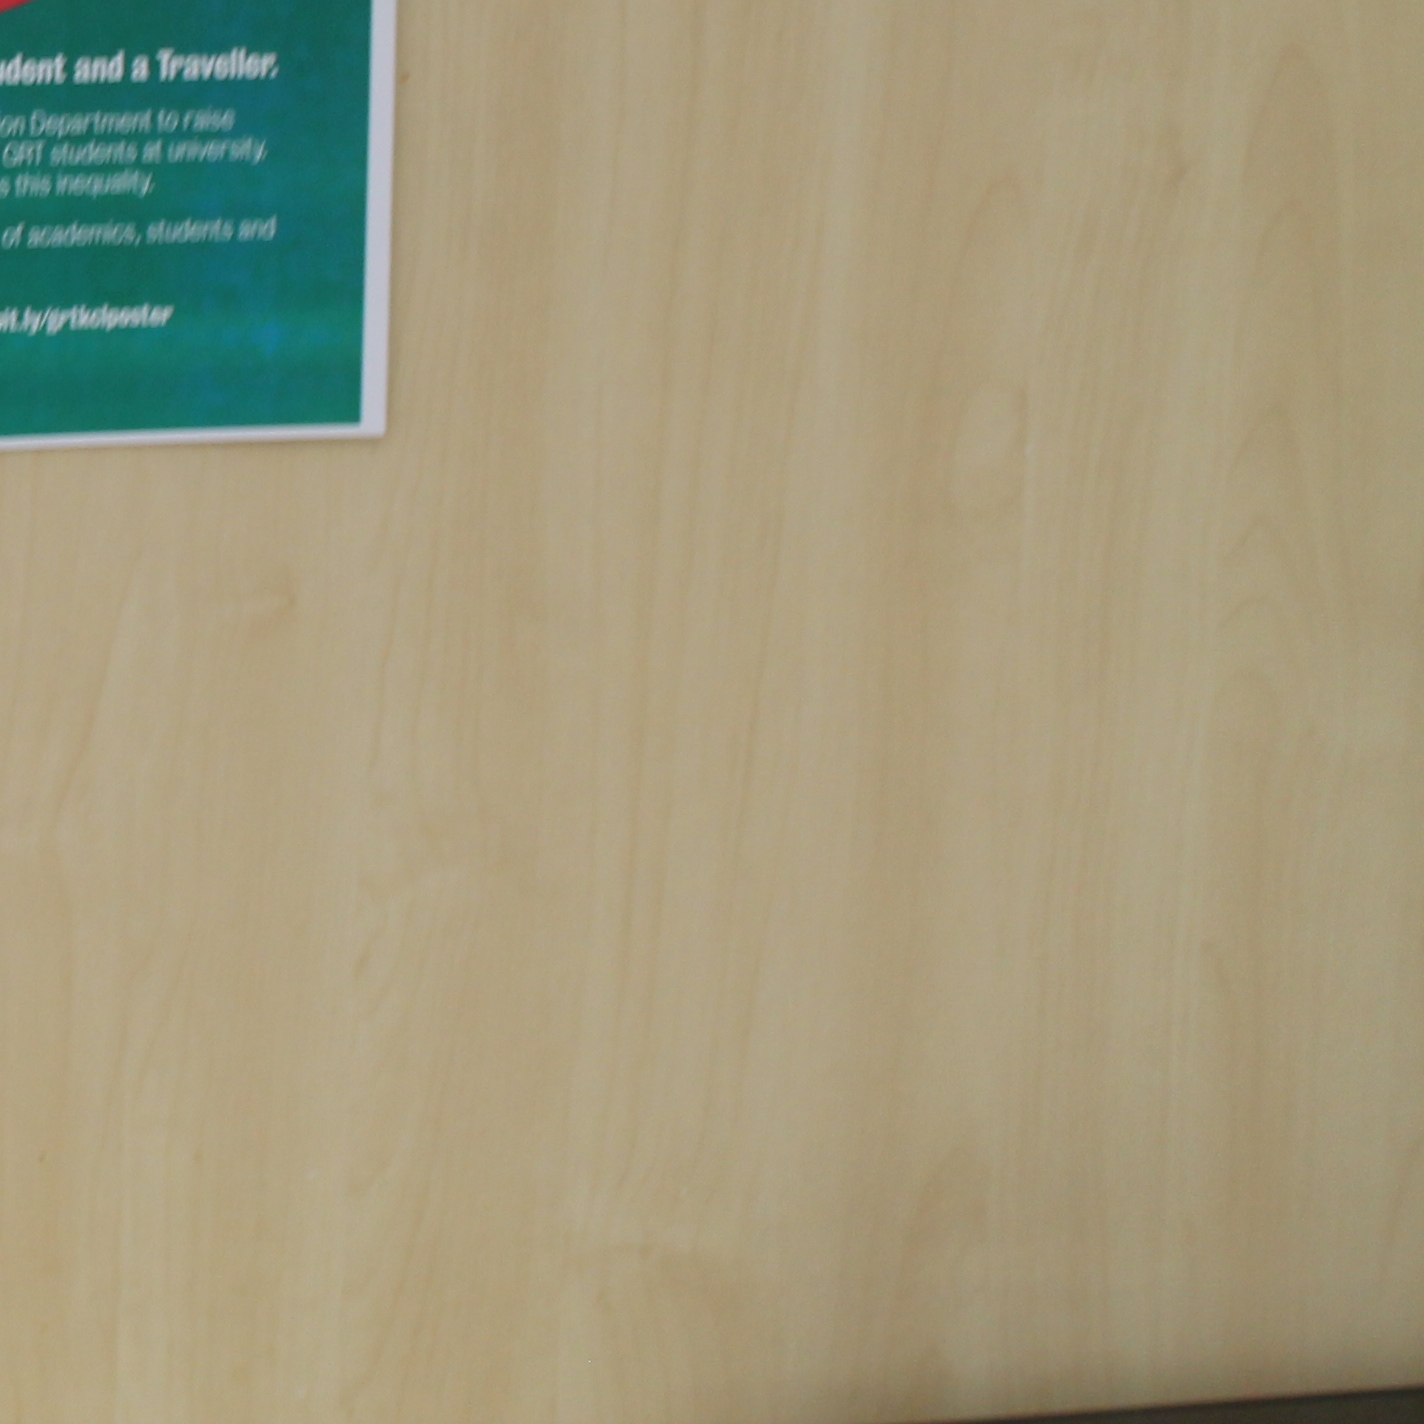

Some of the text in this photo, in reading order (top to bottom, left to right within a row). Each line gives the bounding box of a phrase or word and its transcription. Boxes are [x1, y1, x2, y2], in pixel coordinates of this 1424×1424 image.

[74, 49, 125, 84] and
[132, 54, 149, 84] a
[29, 109, 152, 138] Department
[157, 108, 179, 133] to
[183, 107, 235, 132] raise
[3, 140, 46, 168] GRT
[50, 139, 138, 167] students
[142, 139, 162, 165] at
[15, 171, 51, 198] this
[2, 221, 25, 248] of
[28, 220, 142, 249] academics,
[146, 217, 234, 244] students
[237, 214, 278, 242] and
